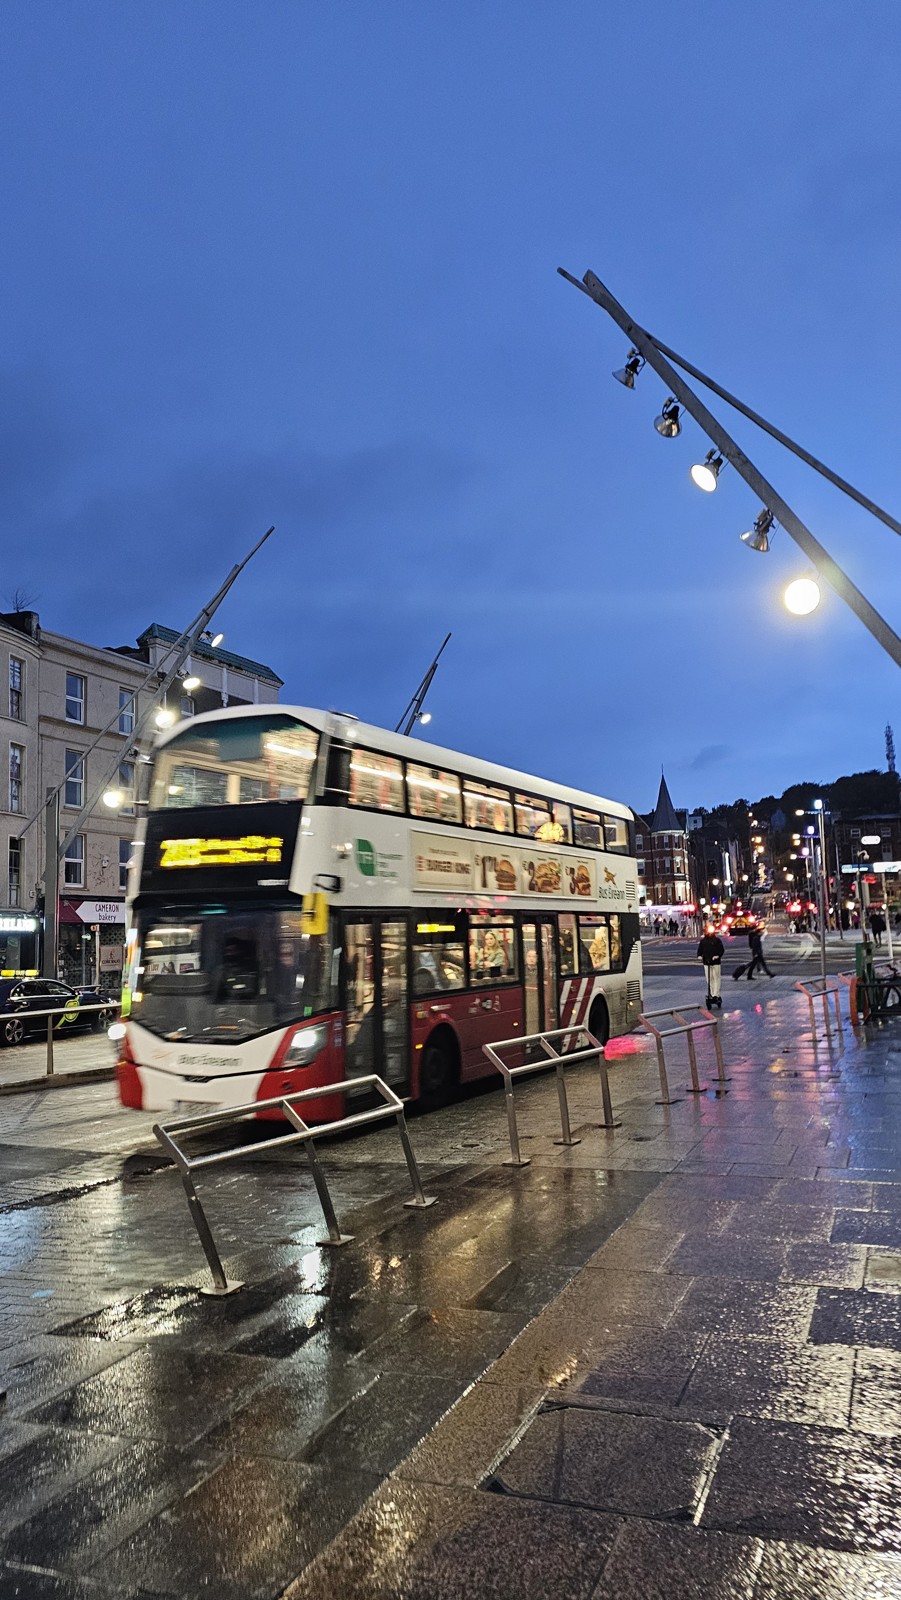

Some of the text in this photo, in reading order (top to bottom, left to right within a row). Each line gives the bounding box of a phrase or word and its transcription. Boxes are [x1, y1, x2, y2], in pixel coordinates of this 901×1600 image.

[598, 886, 607, 899] Bus
[95, 903, 119, 912] CAMERON
[98, 912, 117, 922] bakery
